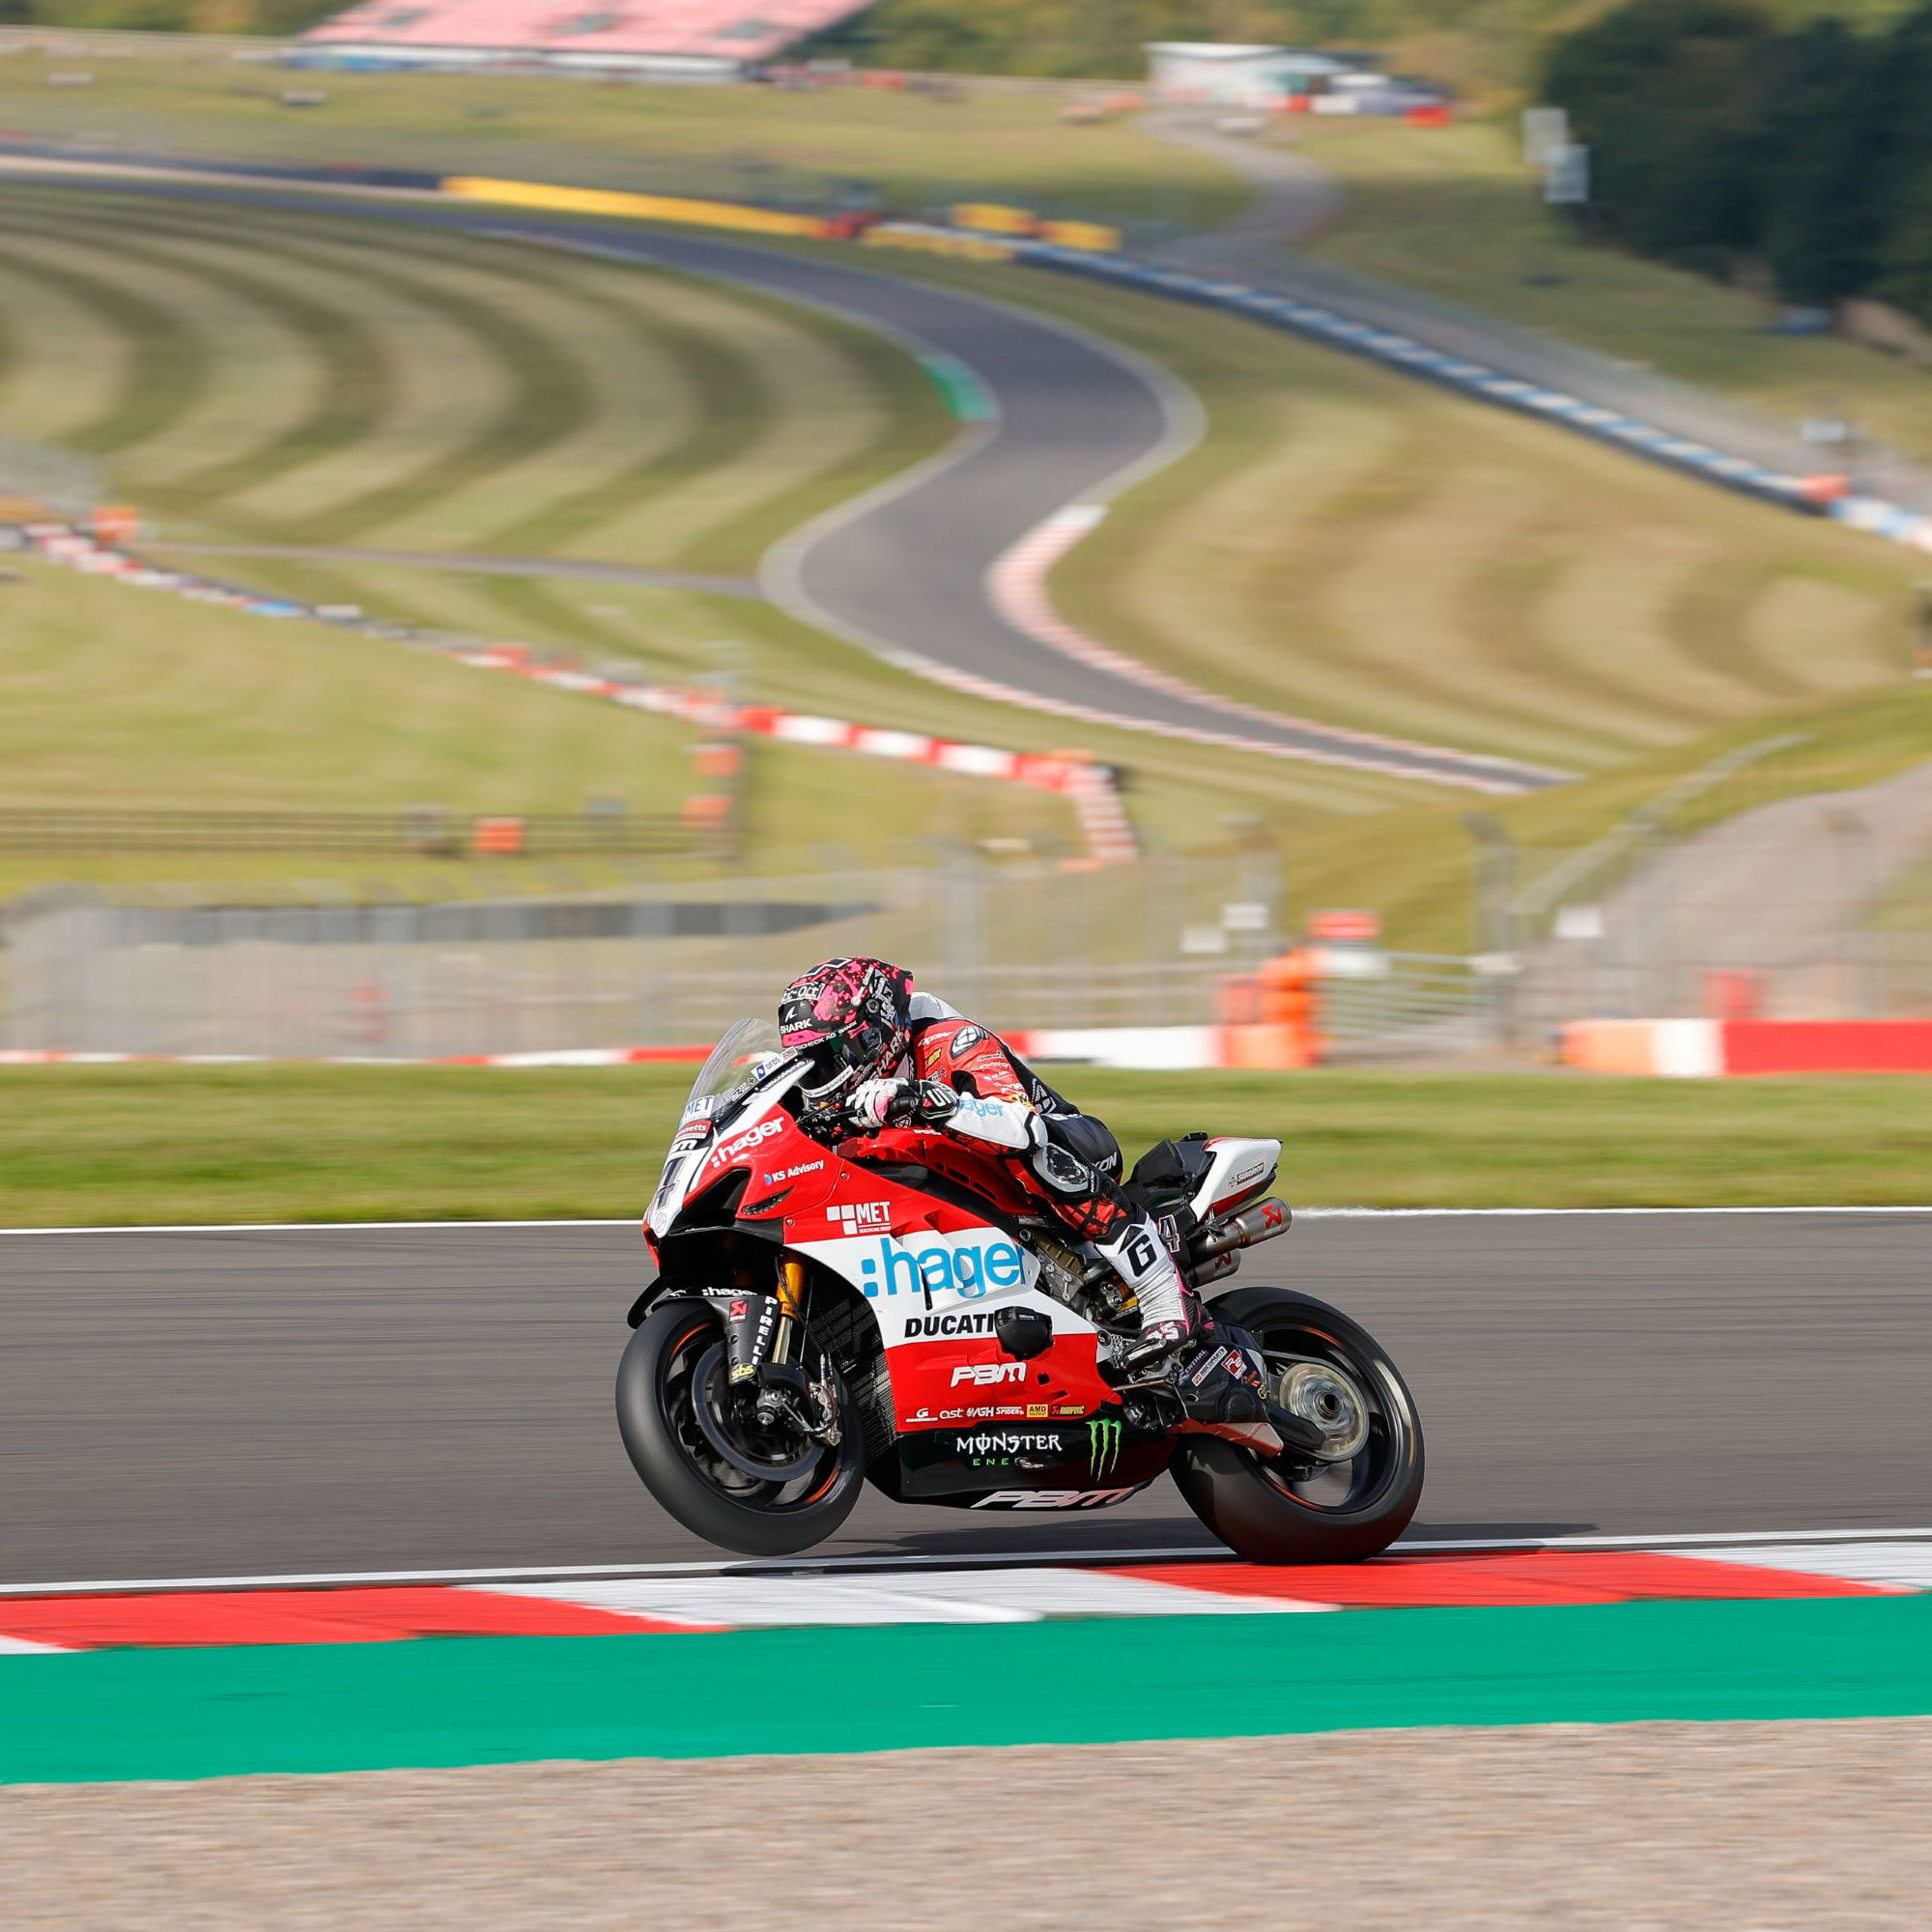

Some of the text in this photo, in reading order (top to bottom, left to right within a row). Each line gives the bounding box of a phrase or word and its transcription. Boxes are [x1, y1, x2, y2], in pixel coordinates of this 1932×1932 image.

[780, 1018, 812, 1035] SHARK
[686, 1096, 713, 1115] MET
[772, 1159, 825, 1182] KS Advisory
[855, 1201, 891, 1224] MET
[1159, 1214, 1180, 1254] 4
[1126, 1234, 1157, 1277] G
[751, 1295, 778, 1366] PIRELLI
[904, 1313, 995, 1338] DUCATI
[730, 1363, 755, 1380] sbs
[950, 1362, 1027, 1388] PBM
[939, 1407, 964, 1419] ast
[956, 1433, 1063, 1455] MONSTER
